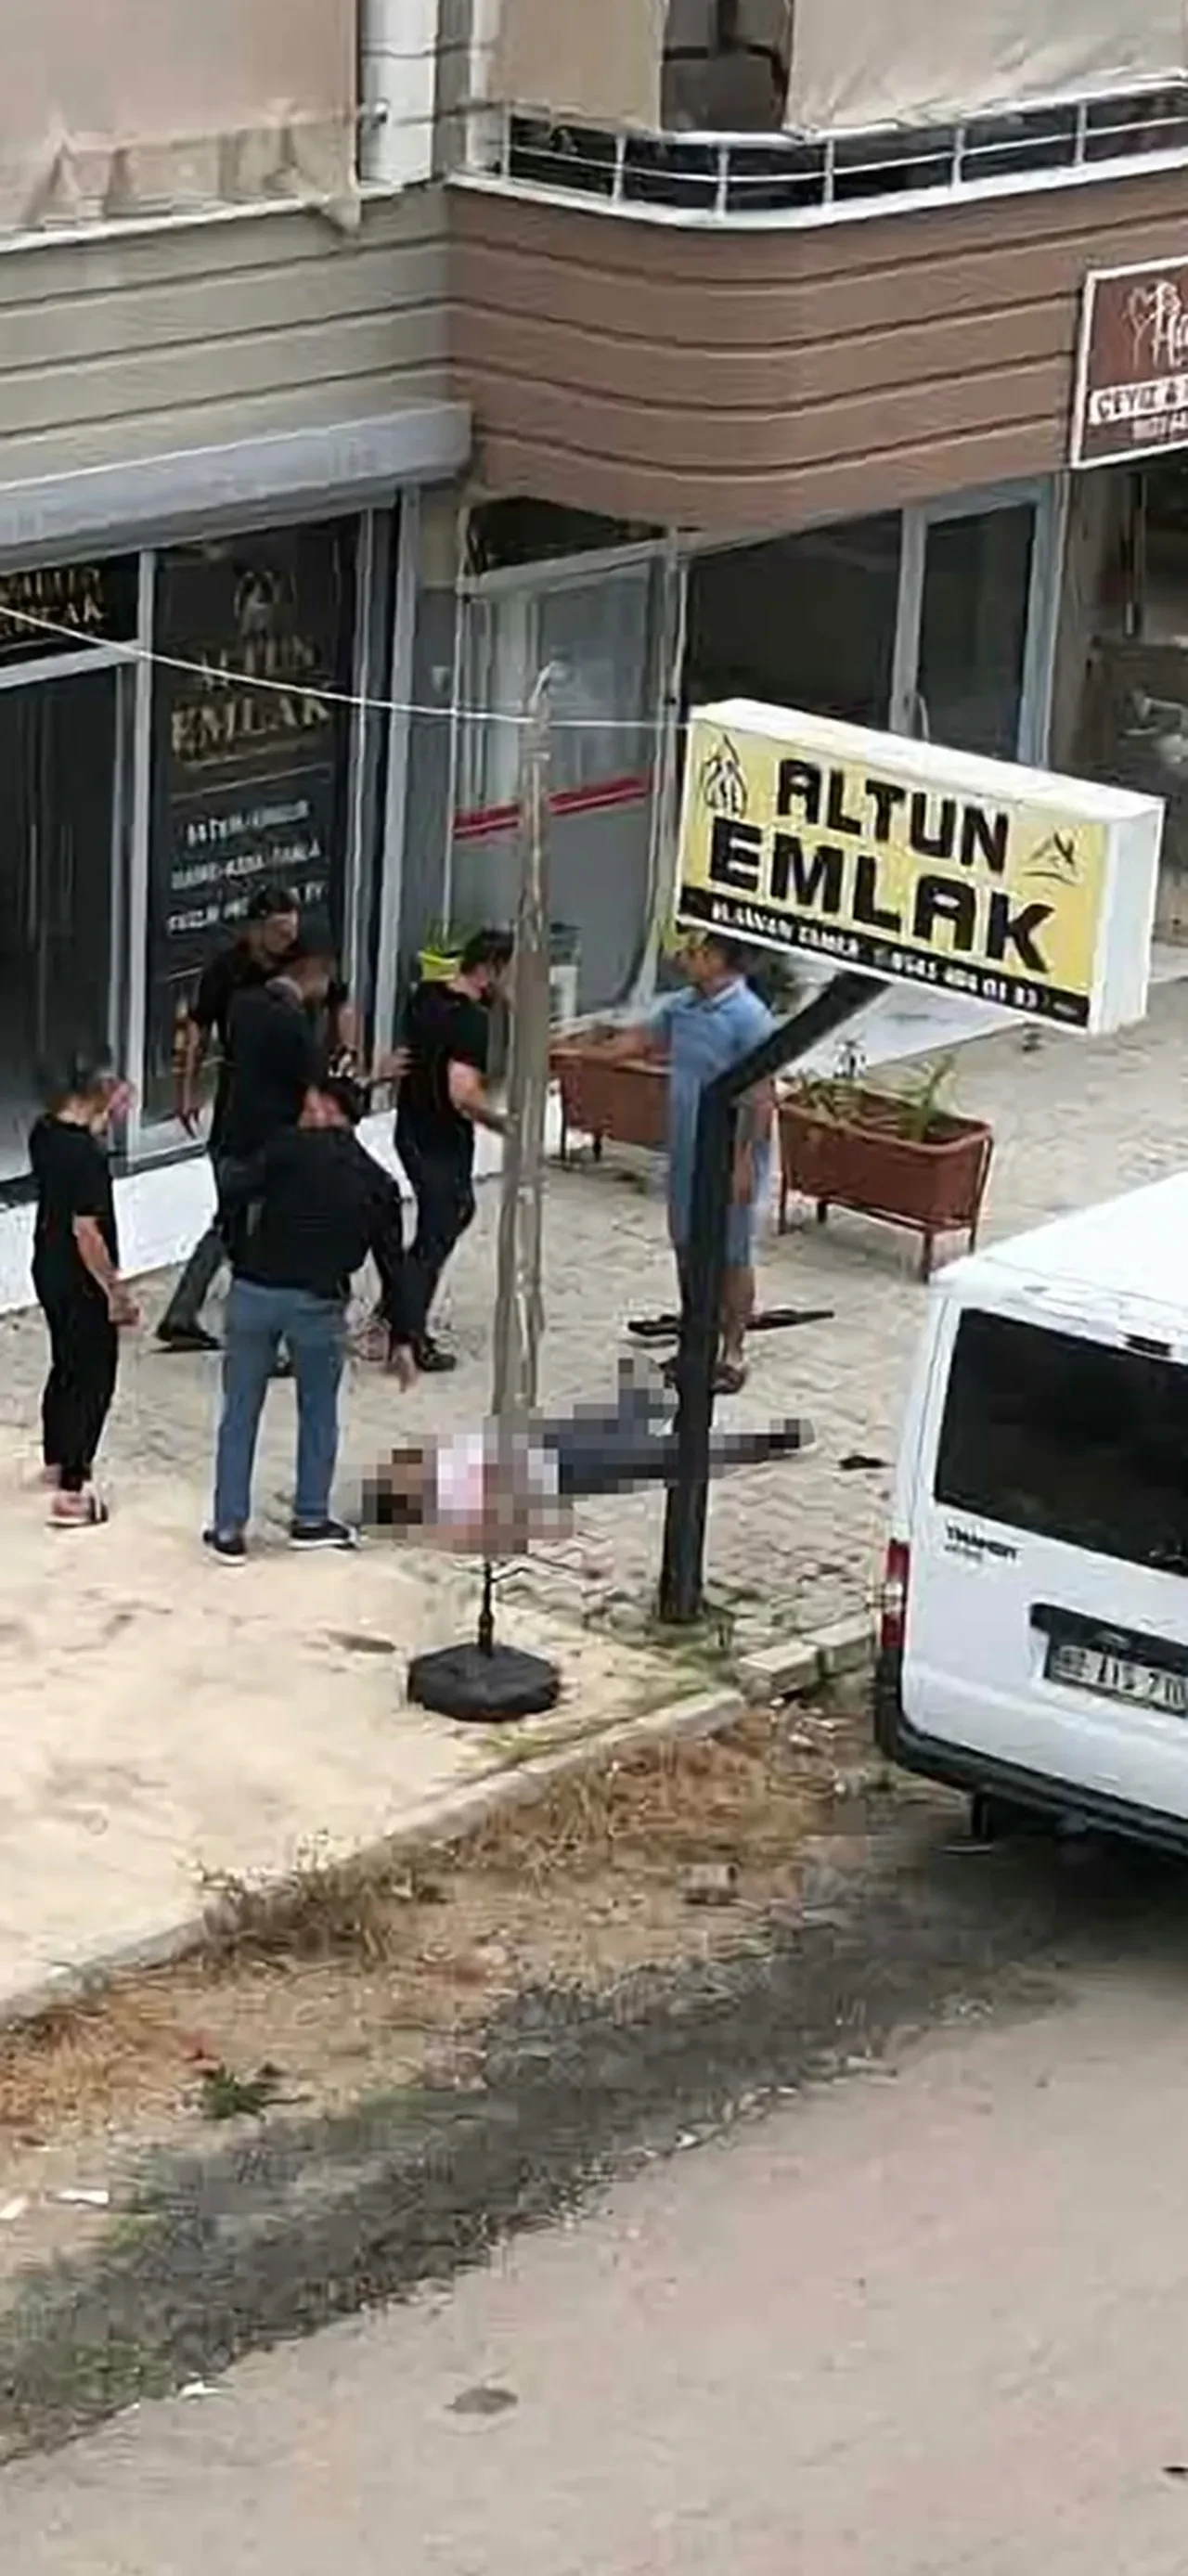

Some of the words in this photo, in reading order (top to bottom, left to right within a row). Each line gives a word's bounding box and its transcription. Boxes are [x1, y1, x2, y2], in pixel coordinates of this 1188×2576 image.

[171, 696, 331, 759] EMLAK
[776, 758, 1008, 873] ALTUN
[708, 816, 1056, 974] EMLAK
